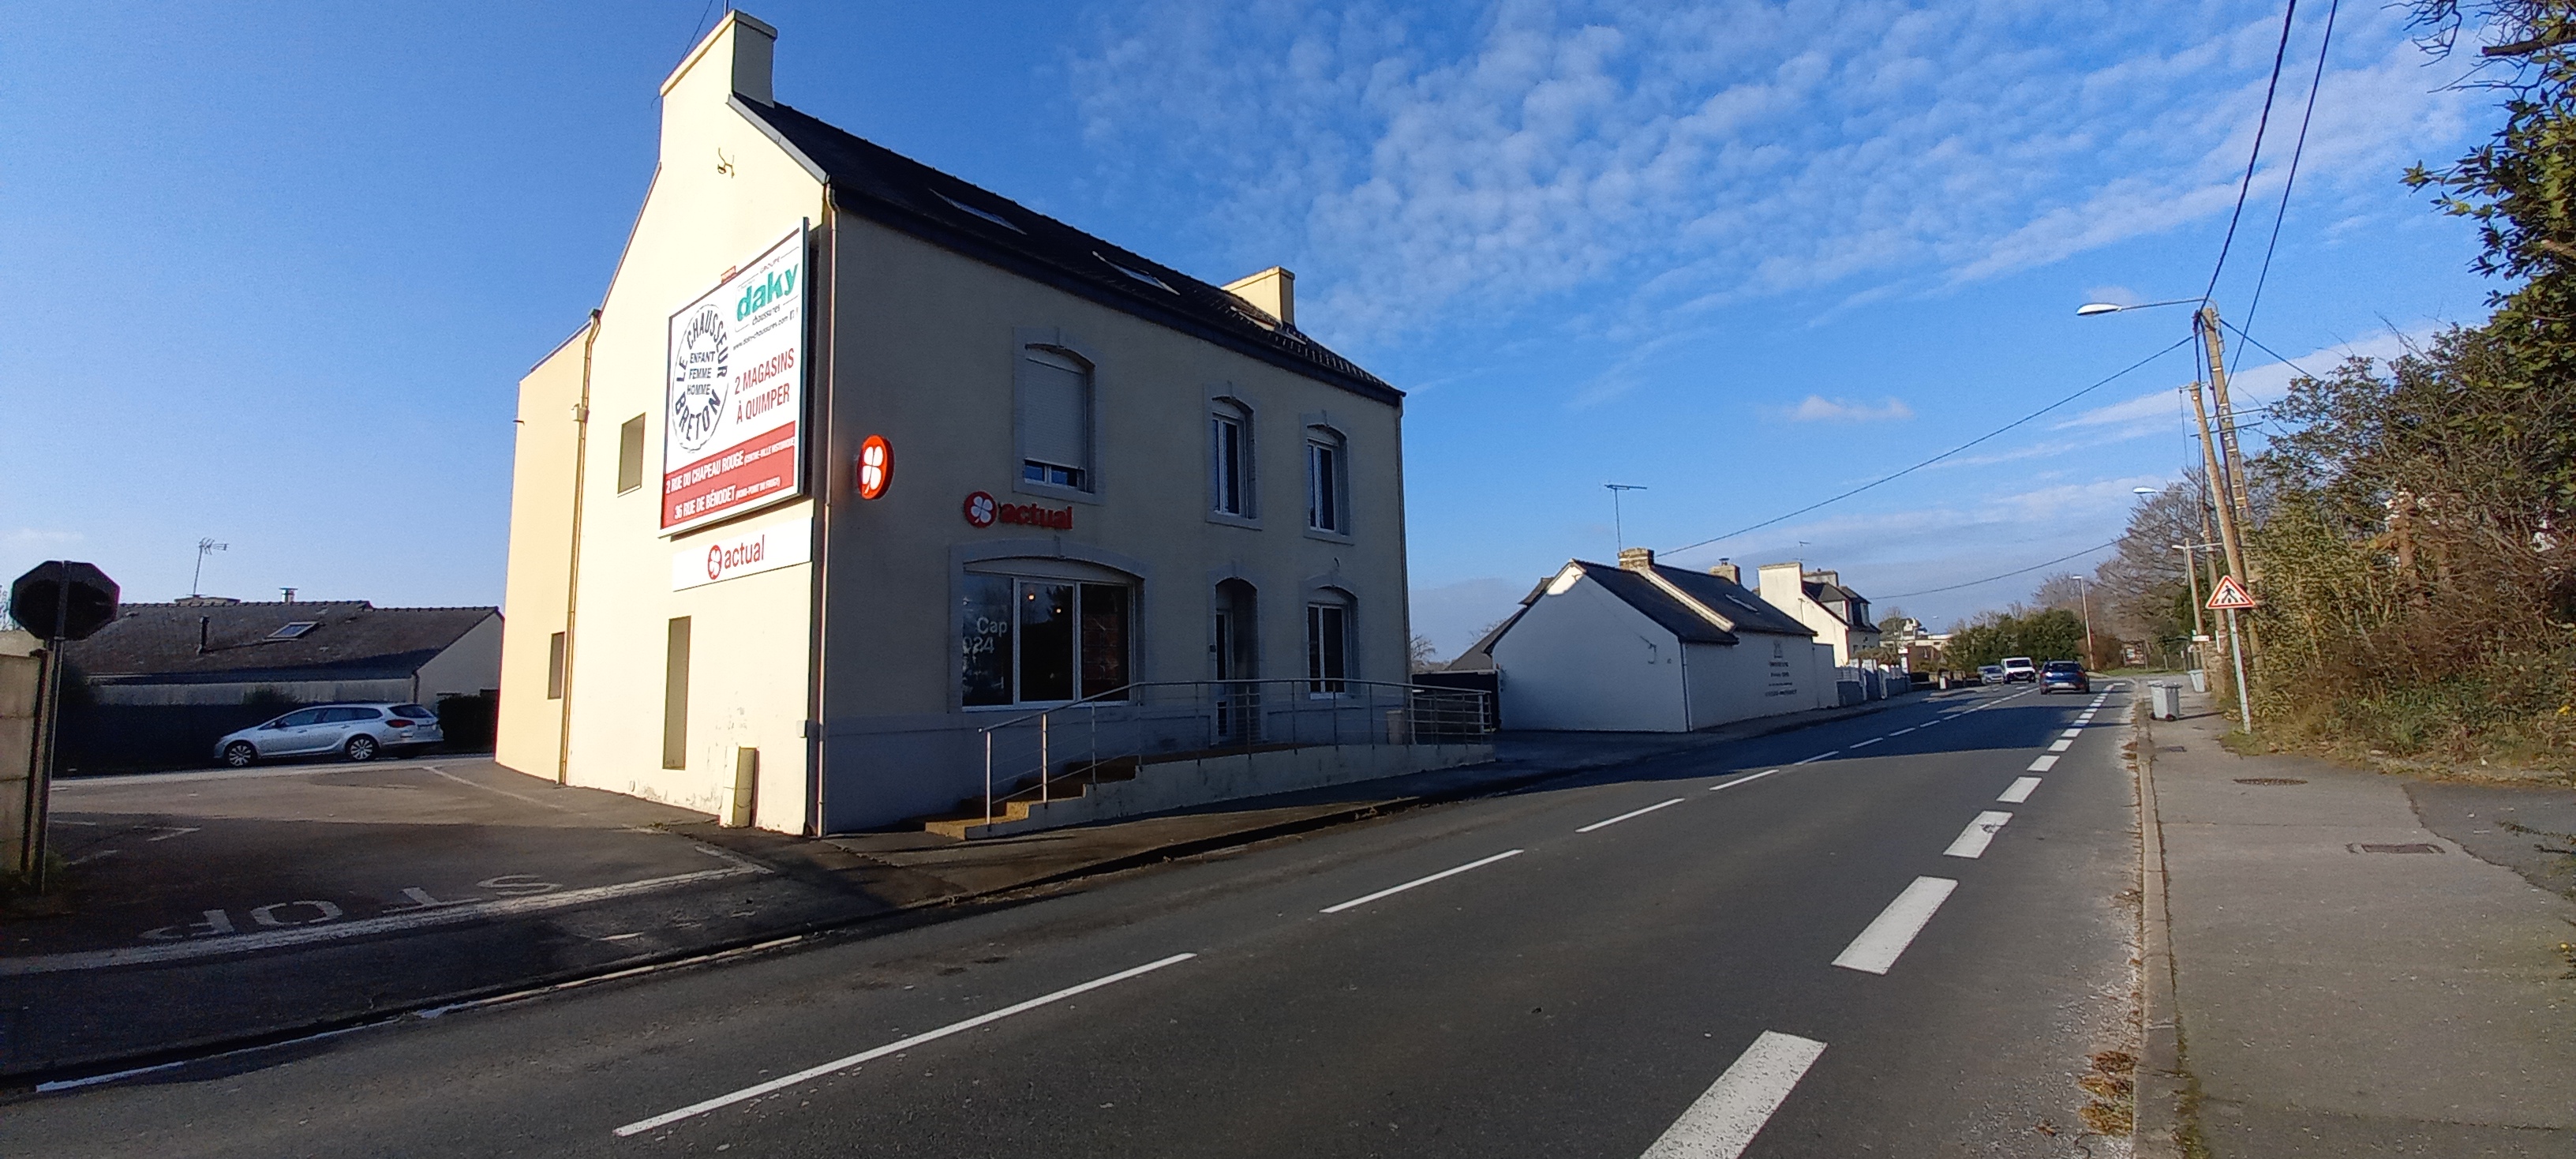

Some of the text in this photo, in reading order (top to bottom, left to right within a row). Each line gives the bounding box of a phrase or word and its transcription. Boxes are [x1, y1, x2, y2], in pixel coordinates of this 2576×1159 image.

[737, 263, 799, 321] daky
[690, 351, 716, 364] ENFANT
[735, 348, 794, 395] 2 MAGASINS
[675, 310, 728, 441] LE CHAUSSEUR BRETON
[689, 367, 712, 380] FEMME
[687, 384, 711, 396] HOMME
[736, 383, 790, 425] À QUIMPER
[665, 480, 671, 494] 2
[671, 475, 683, 492] RUE
[683, 471, 691, 488] DU
[691, 459, 721, 484] CHAPEAU
[721, 450, 744, 473] ROUGE
[696, 496, 705, 512] DE
[706, 485, 736, 510] BÉNODET
[1000, 502, 1073, 530] actual
[724, 534, 765, 569] actual
[977, 617, 1007, 638] Cap
[963, 636, 994, 655] 024
[140, 874, 562, 939] STOP
